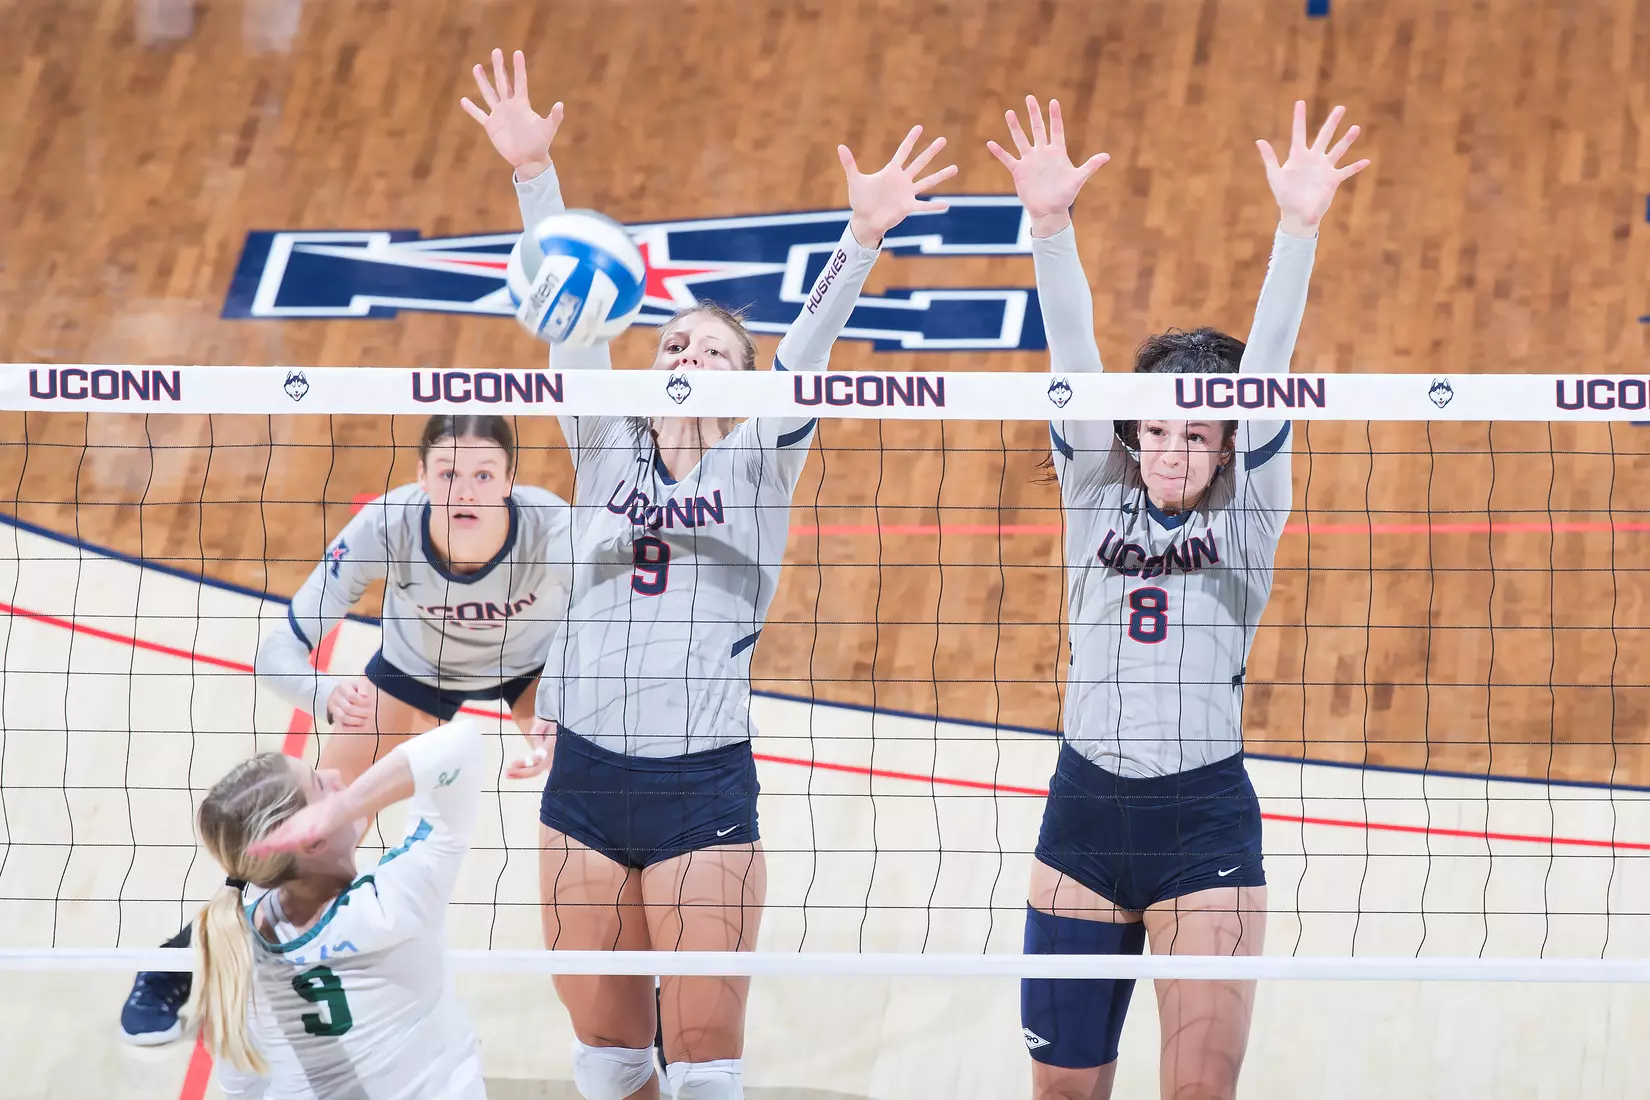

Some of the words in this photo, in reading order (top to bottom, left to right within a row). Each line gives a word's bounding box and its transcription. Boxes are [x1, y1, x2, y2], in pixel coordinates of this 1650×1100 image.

[806, 248, 847, 315] HUSKIES
[29, 369, 181, 401] UCONN
[412, 371, 564, 403] UCONN
[793, 374, 945, 406] UCONN
[1175, 377, 1325, 408] UCONN
[1556, 379, 1650, 411] UCO
[631, 536, 671, 596] 9
[1097, 528, 1219, 580] UCONN
[417, 593, 537, 621] CONN
[1128, 586, 1169, 645] 8
[292, 965, 353, 1036] 9
